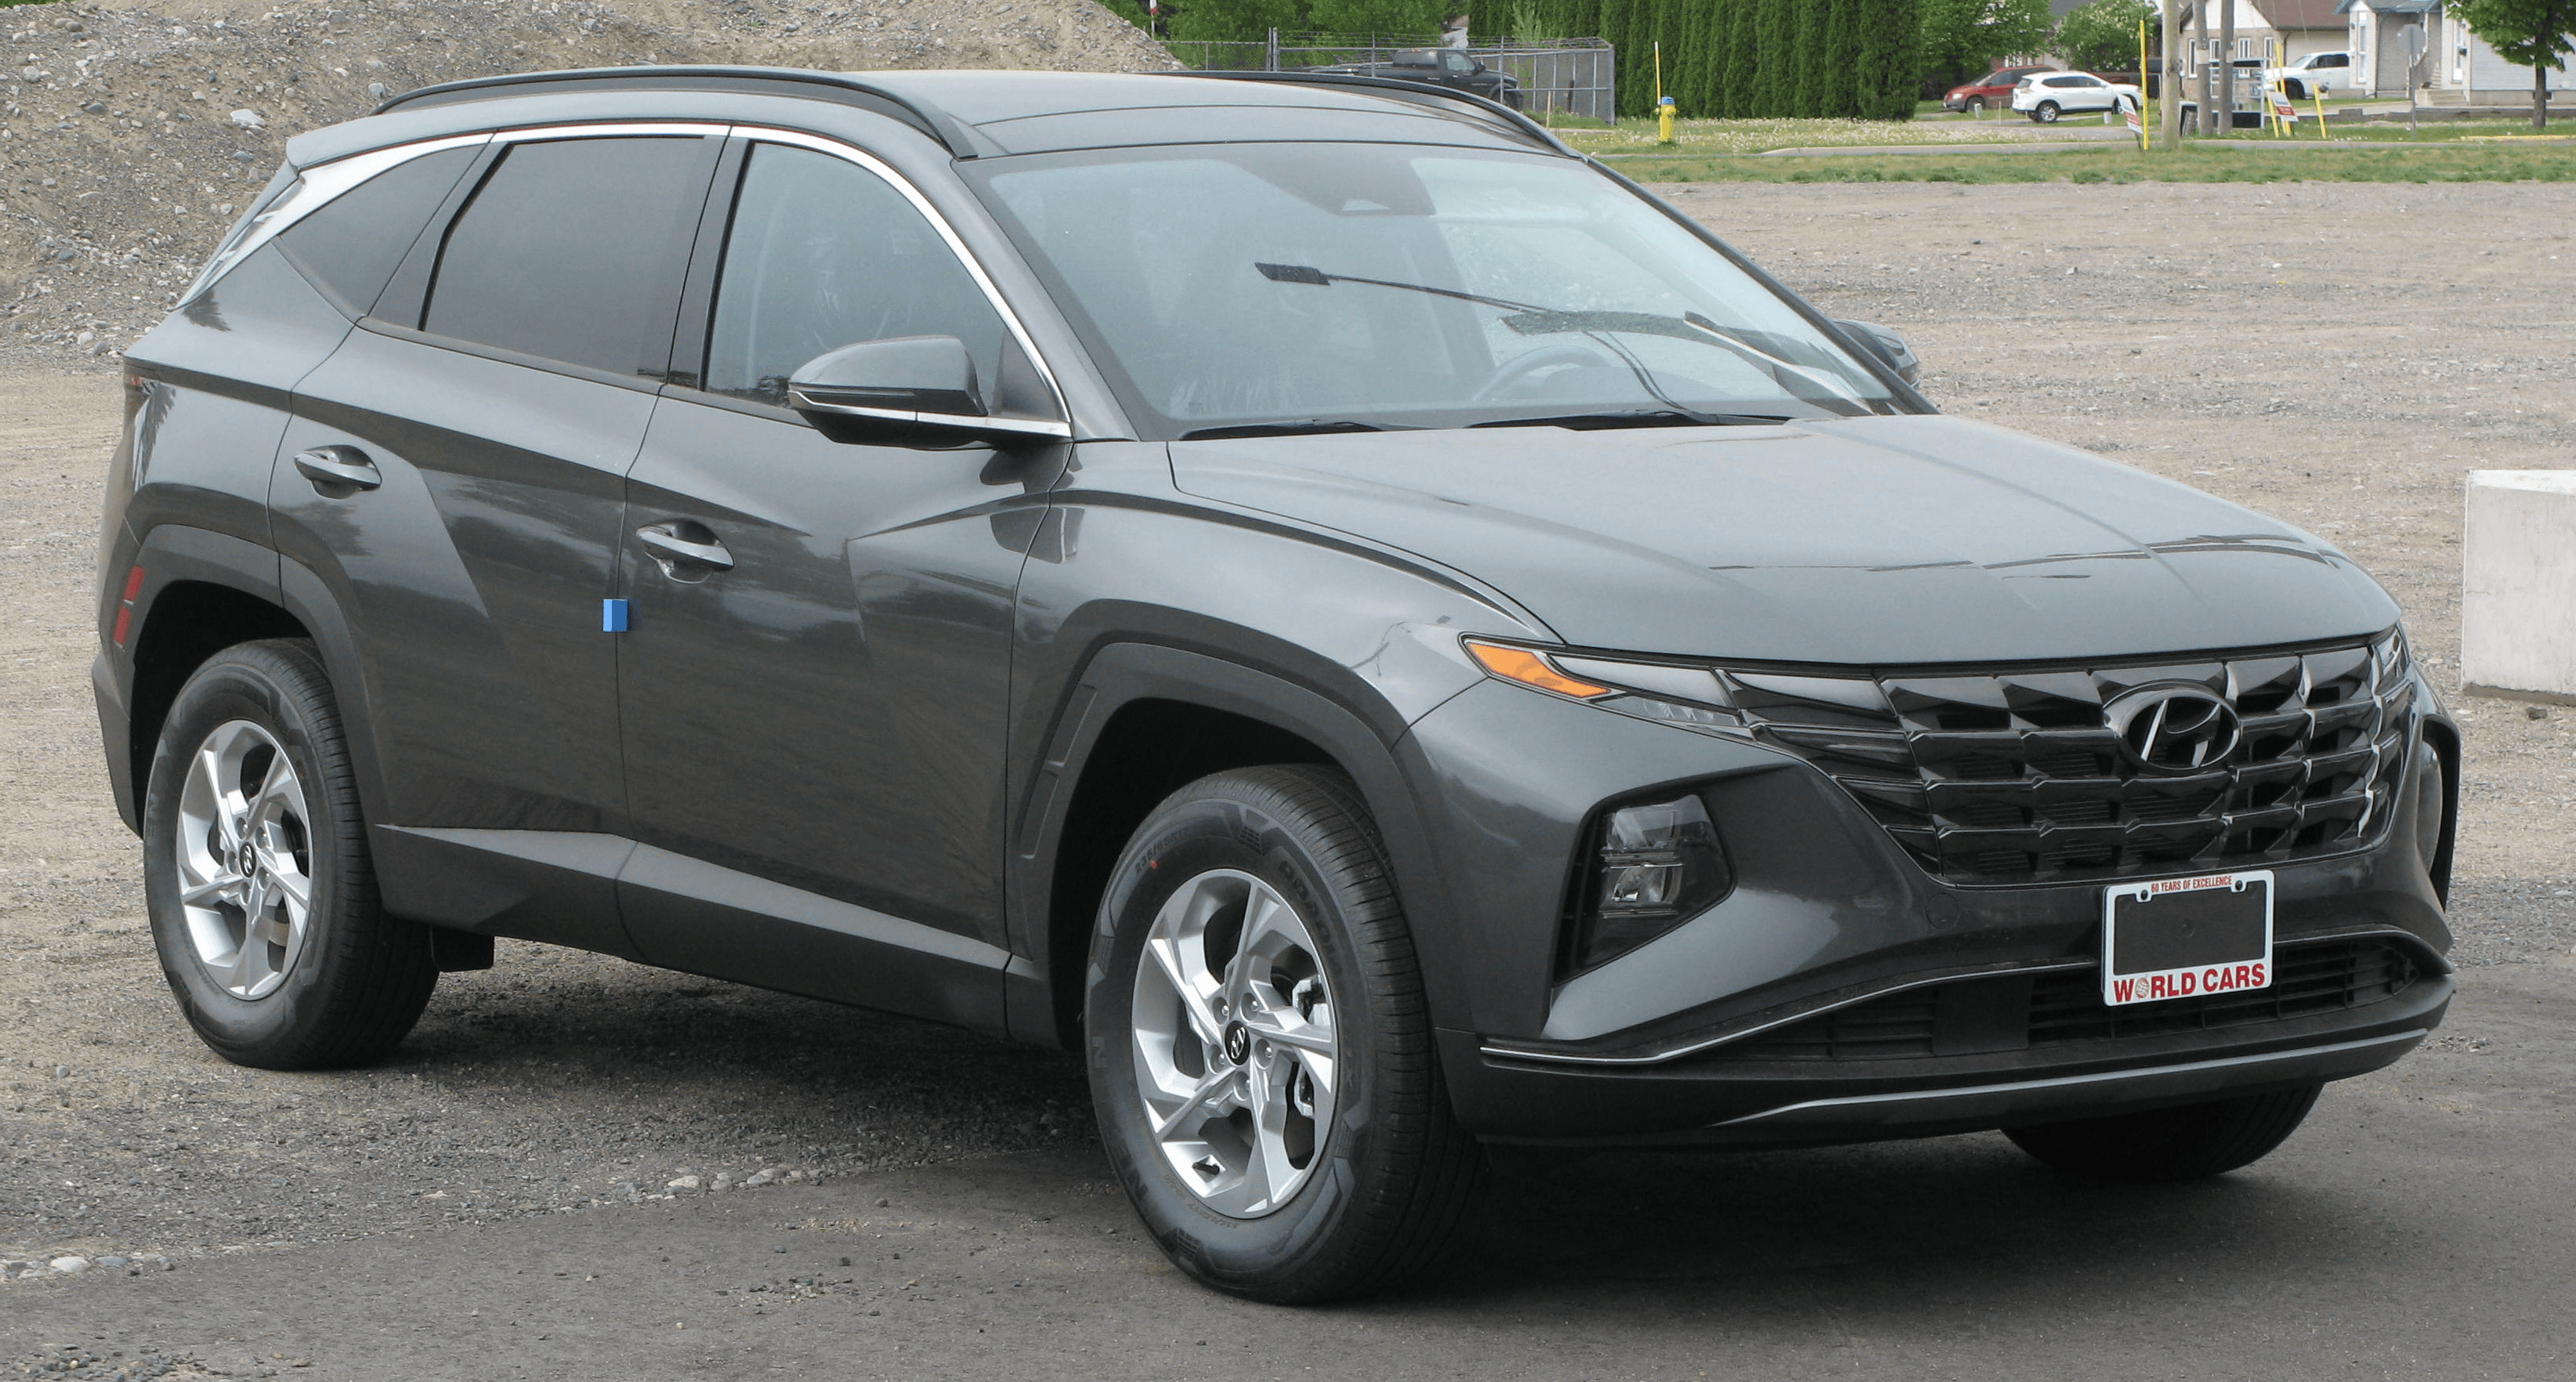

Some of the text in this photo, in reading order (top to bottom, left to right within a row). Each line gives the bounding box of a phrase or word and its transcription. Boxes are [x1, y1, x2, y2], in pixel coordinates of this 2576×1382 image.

[2161, 881, 2181, 892] YEARS
[2183, 880, 2191, 889] OF
[2193, 876, 2232, 888] EXCELLENCE
[2202, 963, 2265, 992] CARS
